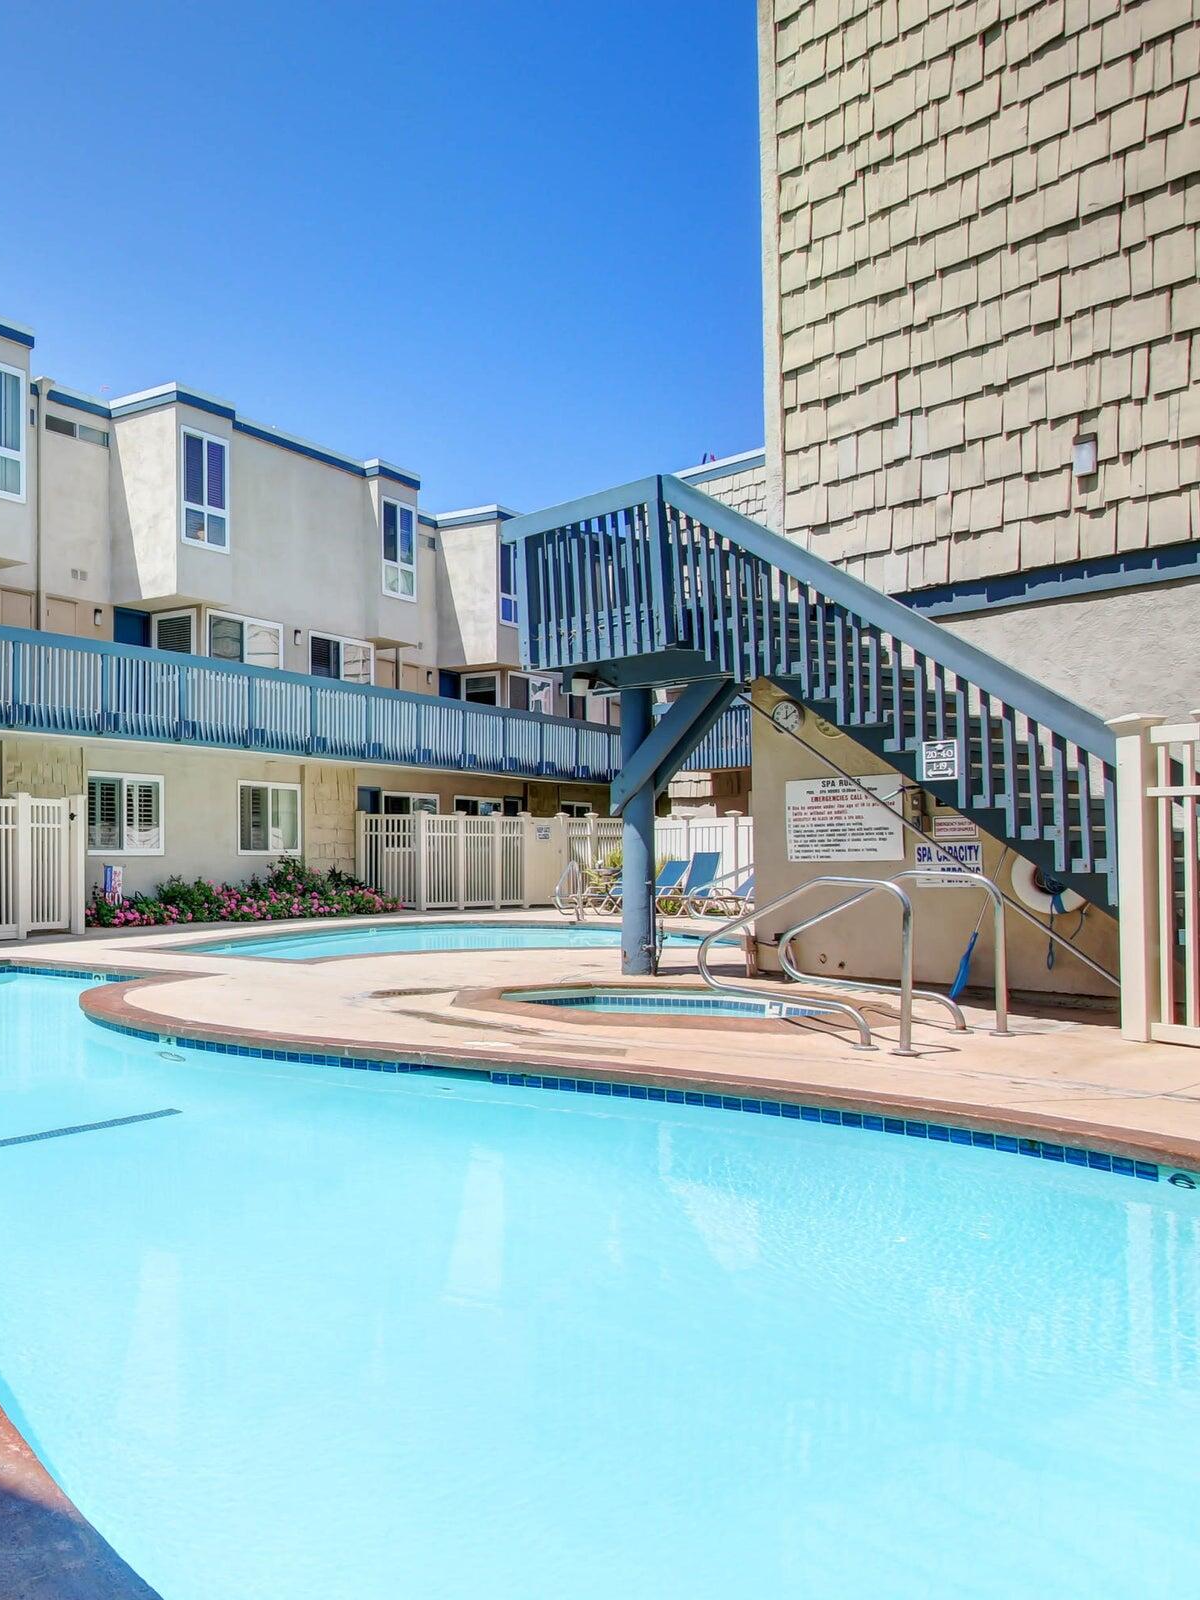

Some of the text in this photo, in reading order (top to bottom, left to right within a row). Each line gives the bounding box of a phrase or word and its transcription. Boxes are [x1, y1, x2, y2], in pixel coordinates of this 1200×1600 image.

[926, 750, 954, 759] 20-40
[933, 762, 948, 770] 1-19
[839, 778, 861, 787] RUS
[917, 846, 932, 862] SPA
